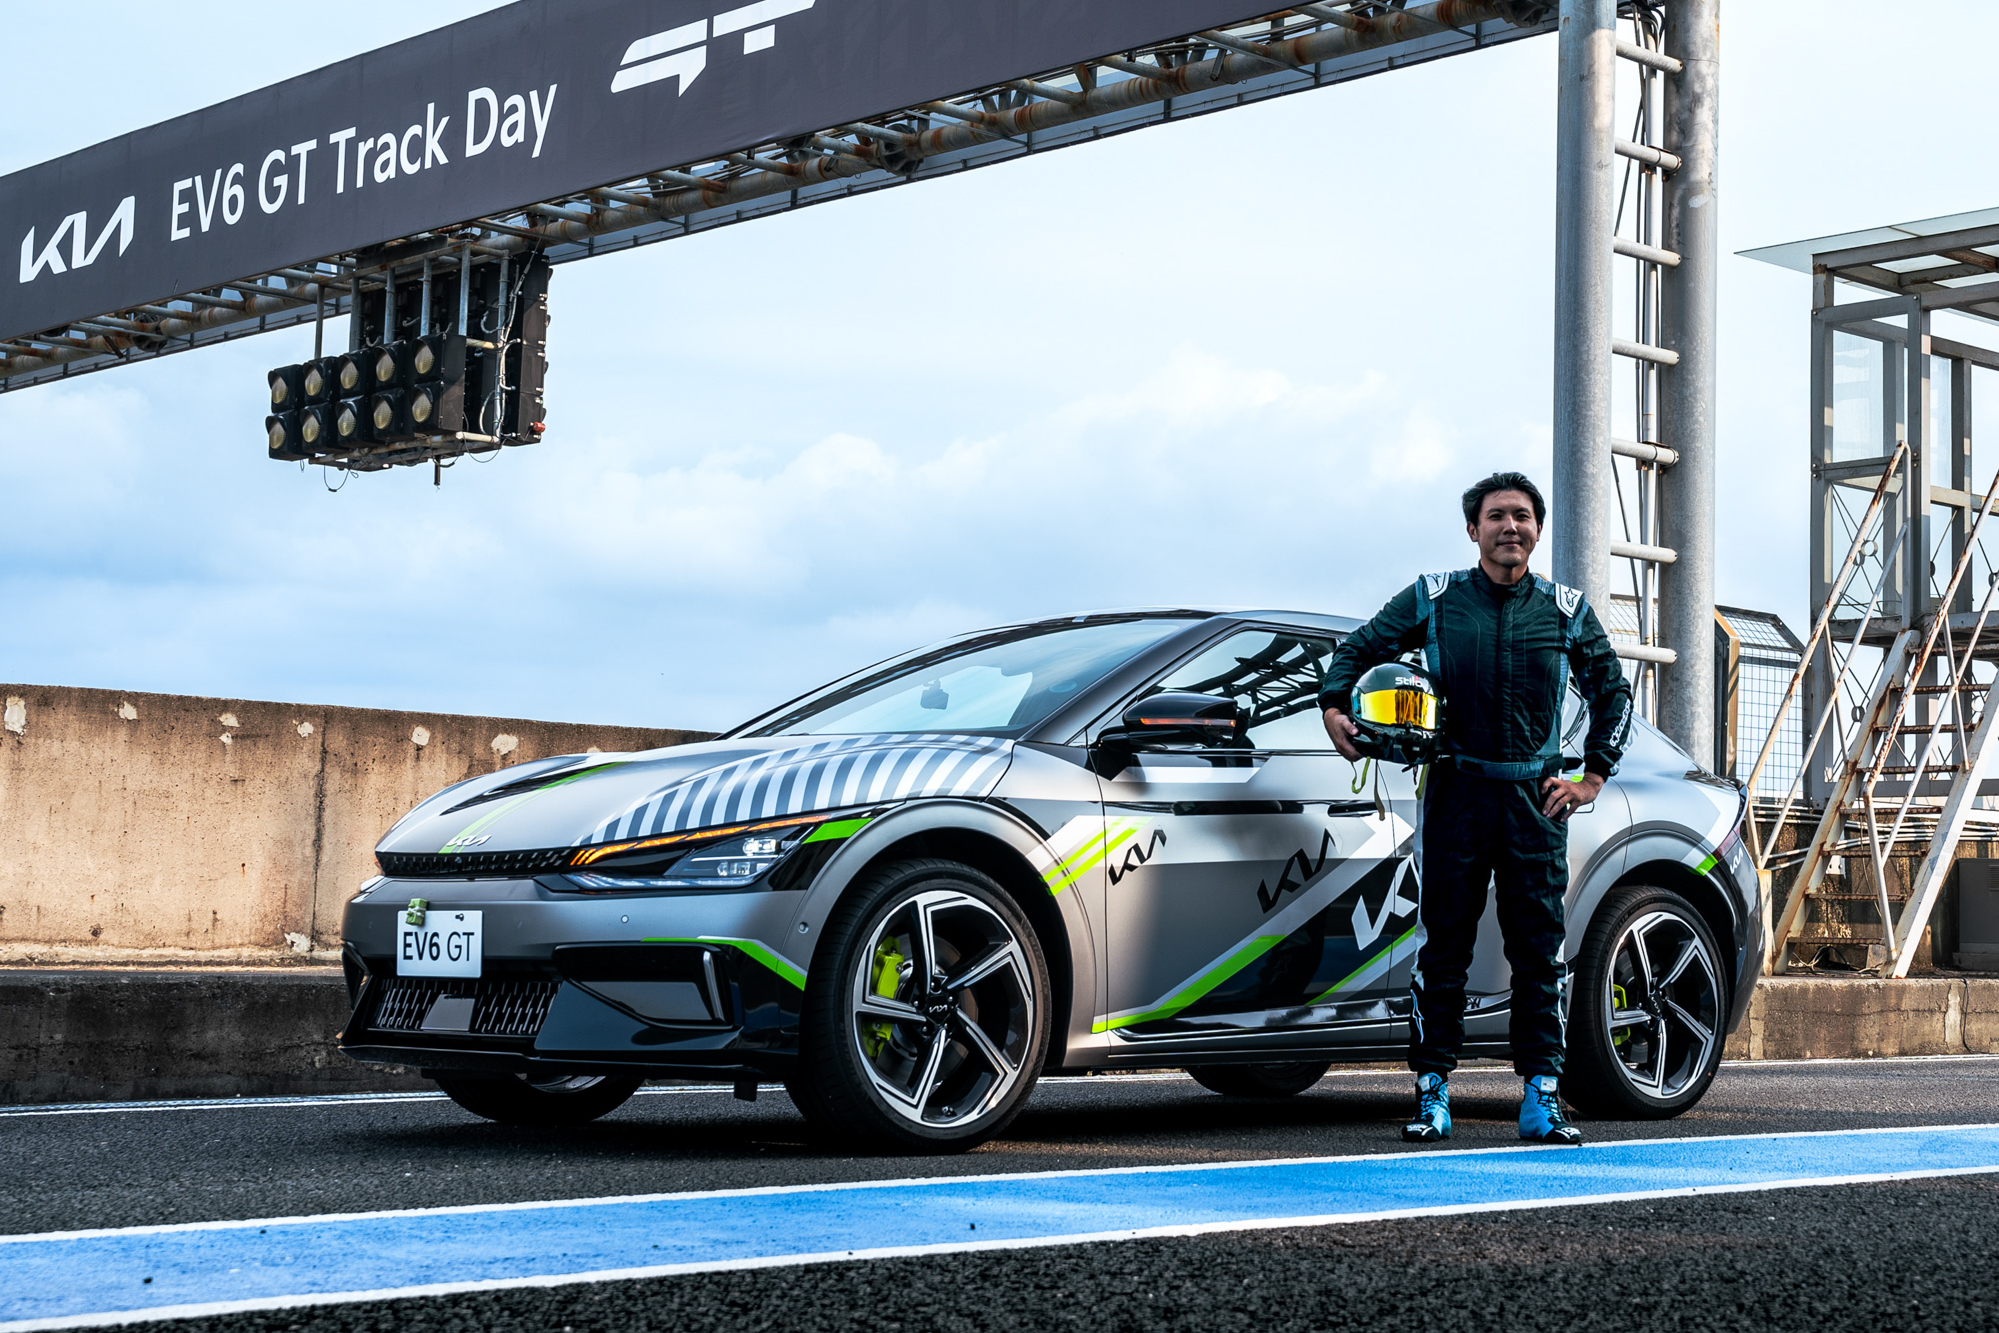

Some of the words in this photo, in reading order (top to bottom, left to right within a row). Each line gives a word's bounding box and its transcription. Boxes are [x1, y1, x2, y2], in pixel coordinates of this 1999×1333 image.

[170, 162, 245, 242] EV6
[258, 138, 317, 214] GT
[329, 102, 450, 194] Track
[465, 84, 558, 159] Day
[403, 931, 441, 962] EV6
[447, 931, 475, 962] GT
